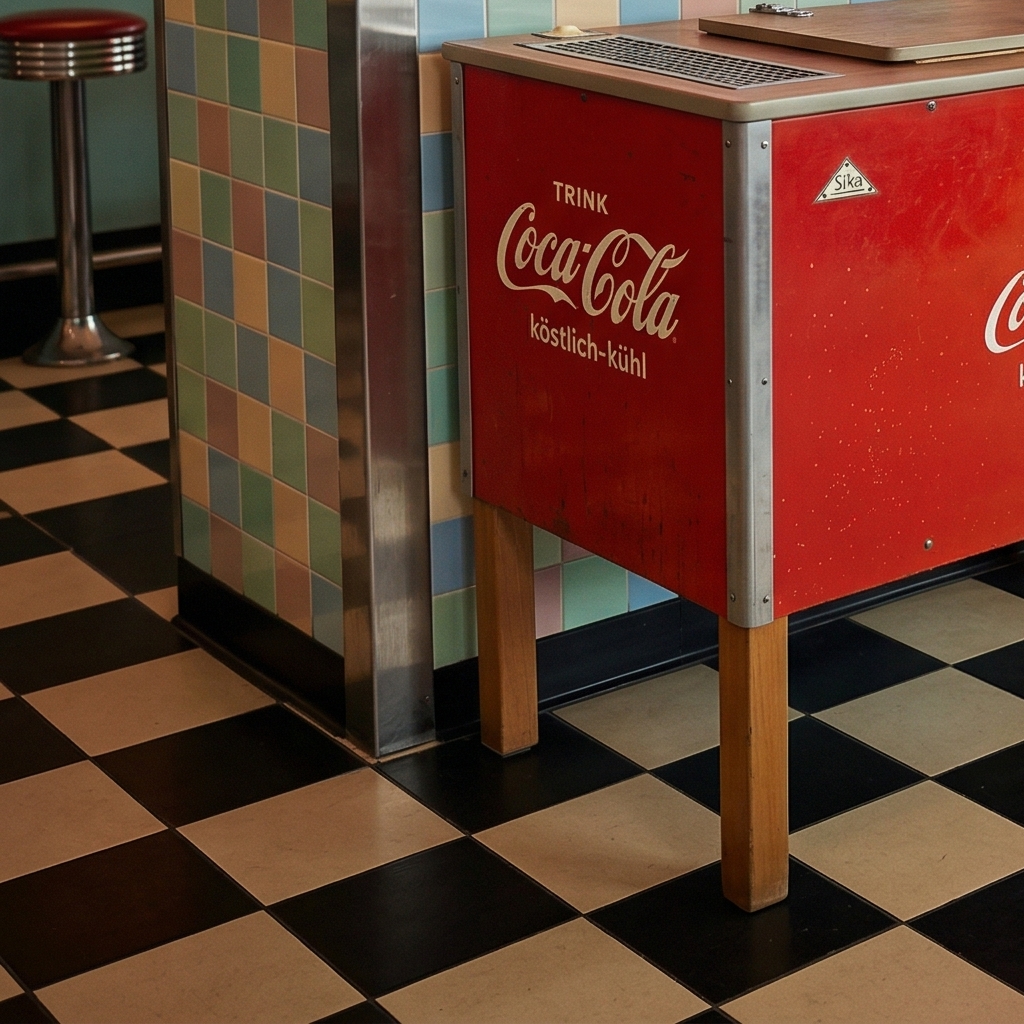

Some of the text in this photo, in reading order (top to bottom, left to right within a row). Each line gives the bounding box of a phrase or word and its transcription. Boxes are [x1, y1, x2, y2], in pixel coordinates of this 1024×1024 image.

[553, 180, 609, 215] TRINK
[834, 173, 863, 191] Sika
[496, 202, 690, 340] Coca-Cola
[530, 312, 647, 379] köstlich-kühl
